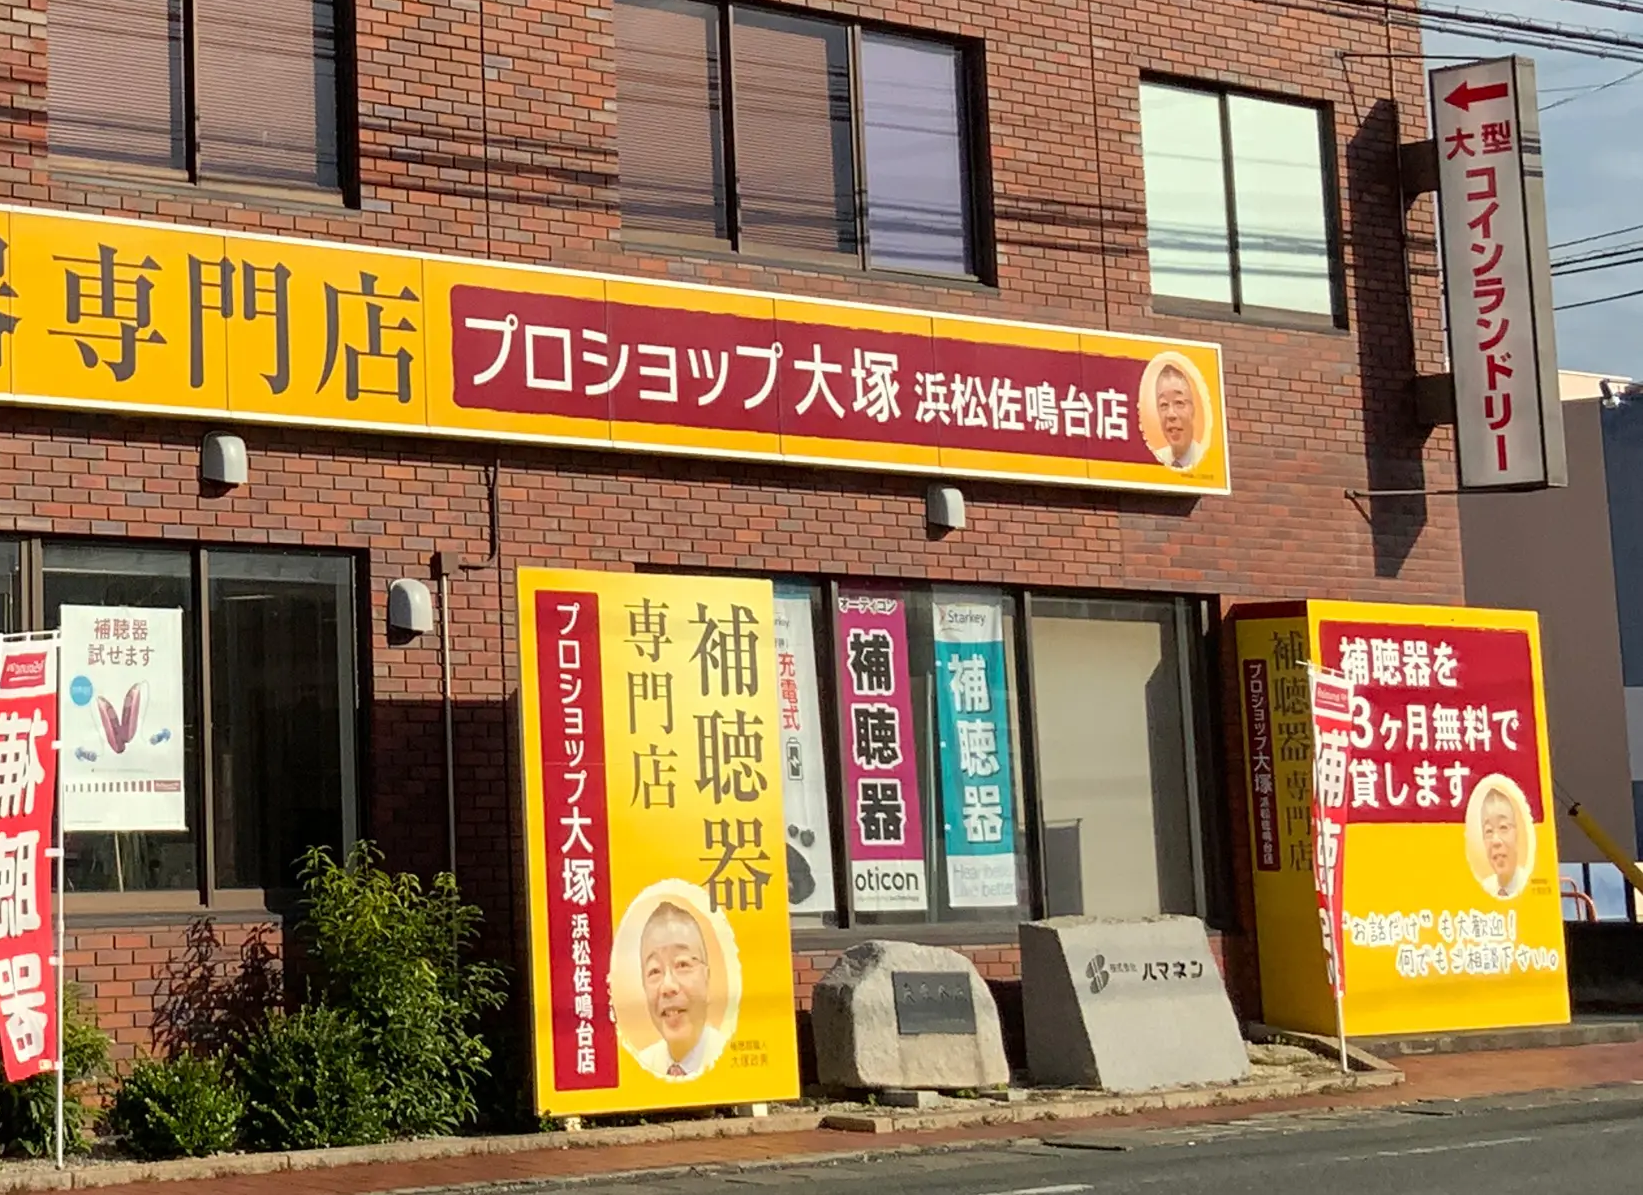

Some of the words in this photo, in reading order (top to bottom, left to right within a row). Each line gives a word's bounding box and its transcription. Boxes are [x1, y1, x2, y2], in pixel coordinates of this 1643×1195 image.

[1444, 119, 1512, 162] 大型
[464, 312, 900, 424] プロショップ大塚
[914, 373, 1130, 442] 浜松佐鳴台店
[1465, 166, 1514, 471] コインランドリー
[87, 644, 155, 667] 試せます
[93, 618, 148, 641] 補聴器
[838, 596, 898, 615] オーティコン
[948, 610, 986, 627] Starkey
[1339, 636, 1458, 687] 補聴器を
[555, 603, 596, 905] プロショップ大塚
[623, 598, 678, 810] 専門店
[688, 602, 773, 913] 補聴器
[778, 653, 800, 732] 充電式
[846, 628, 906, 846] 補聴器
[947, 653, 1003, 844] 補聴器
[1249, 664, 1272, 794] プロショップ大塚
[1269, 629, 1314, 872] 補聴器専門店
[855, 867, 919, 891] oticon
[571, 914, 596, 1074] 浜松佐鳴台店
[1142, 960, 1203, 981] ハマネン
